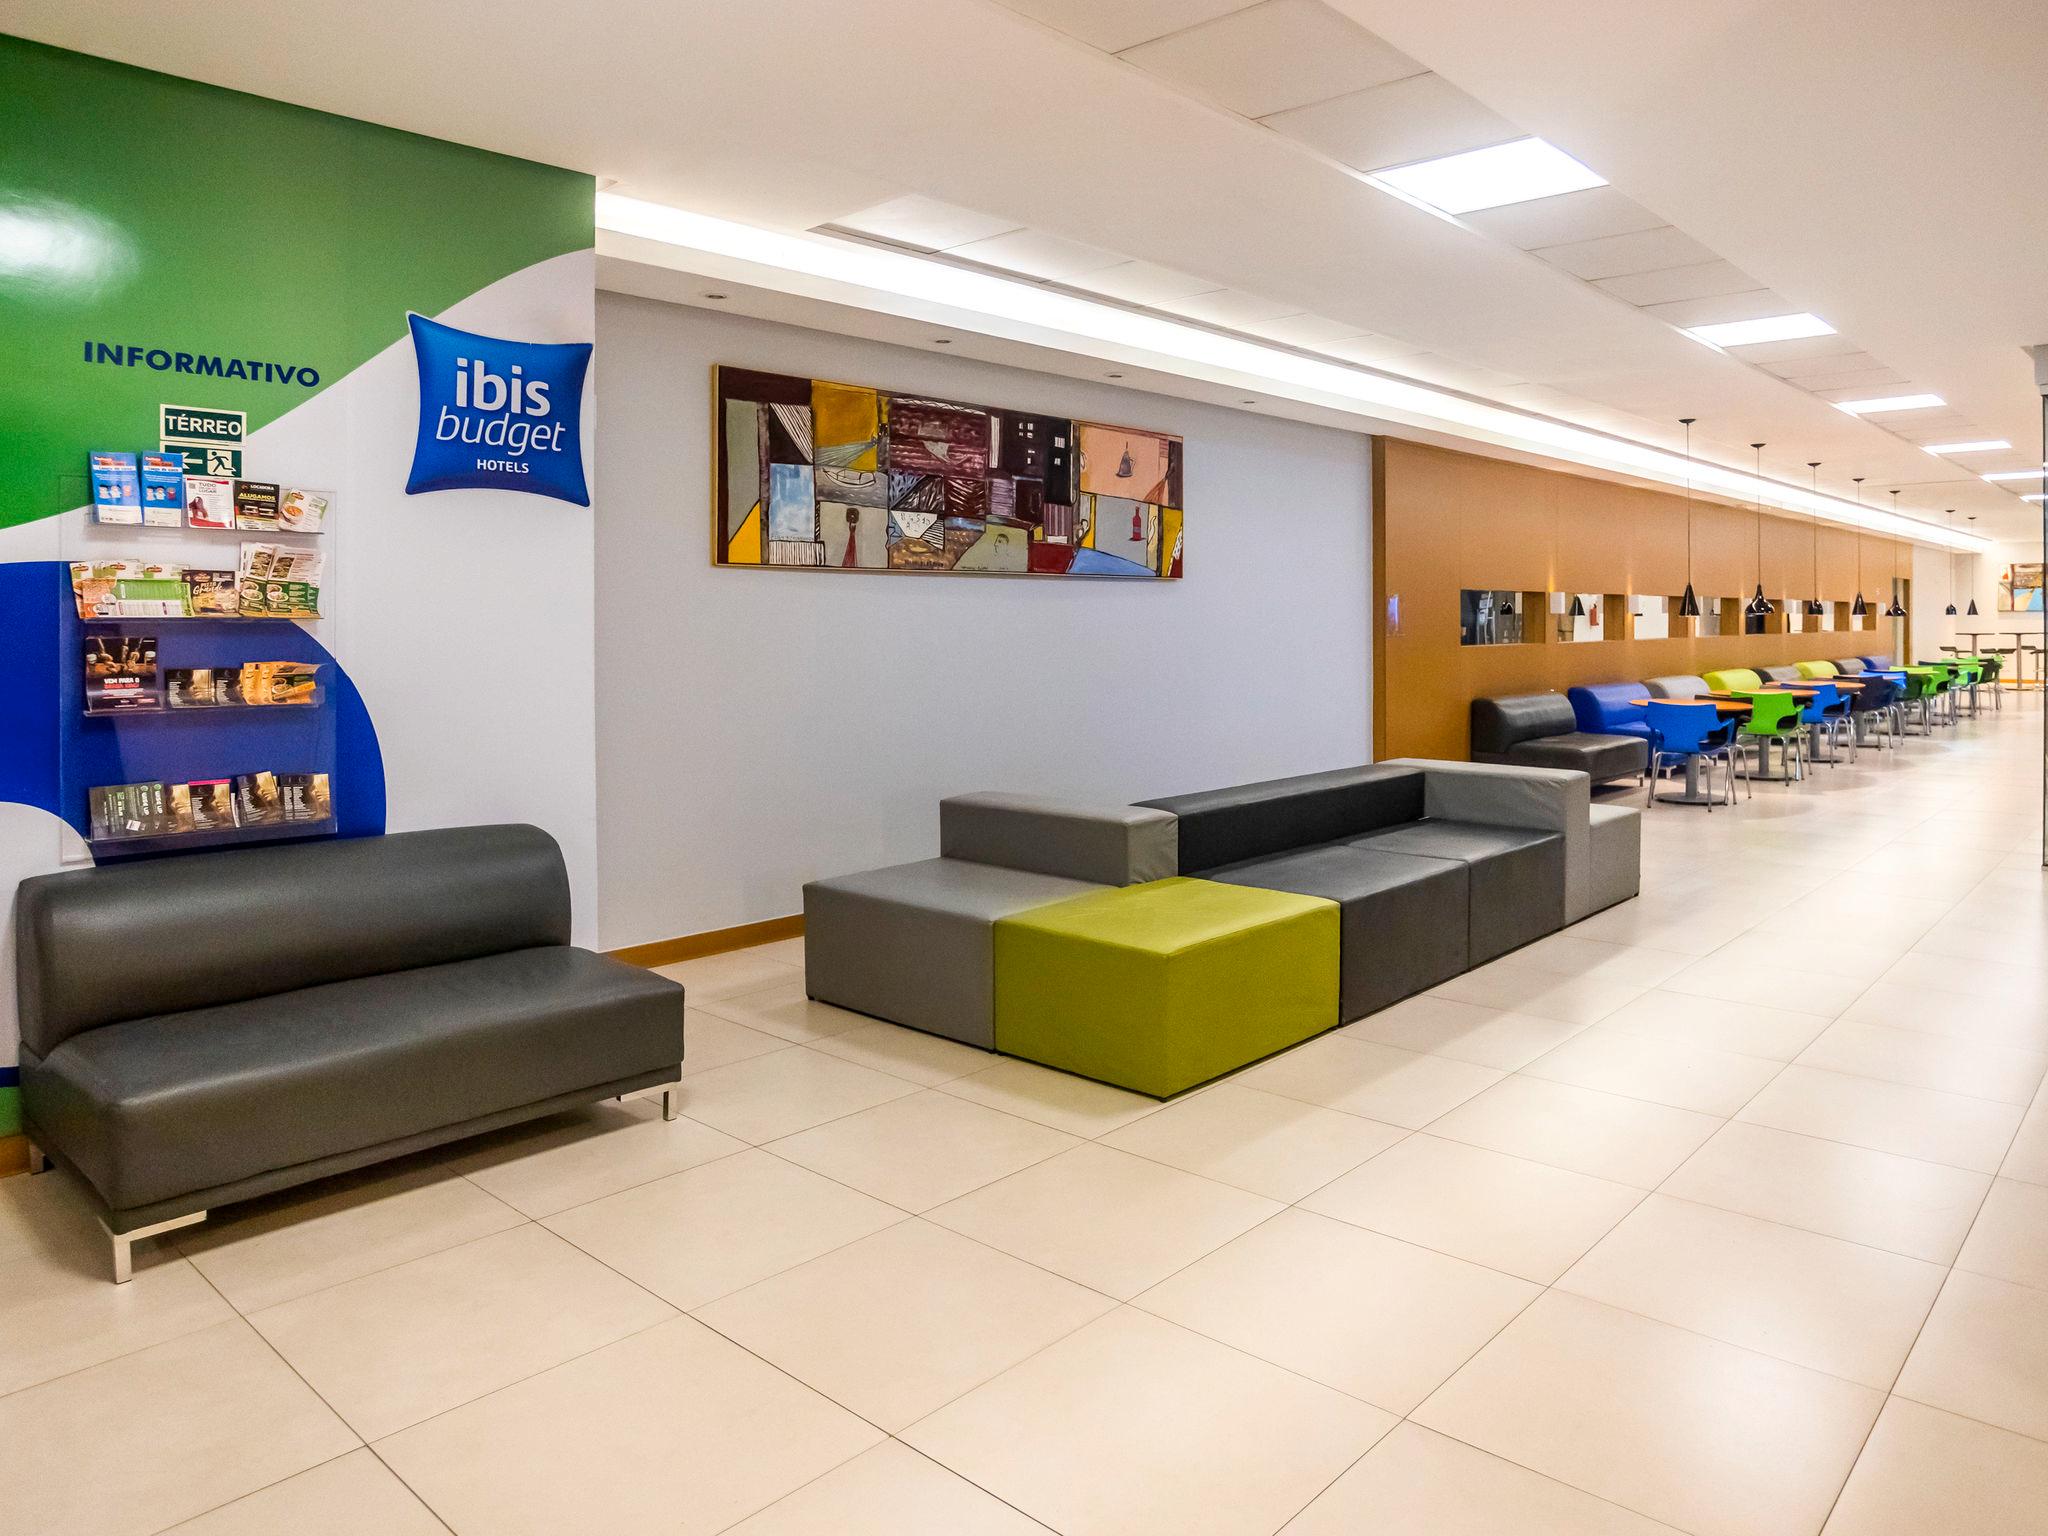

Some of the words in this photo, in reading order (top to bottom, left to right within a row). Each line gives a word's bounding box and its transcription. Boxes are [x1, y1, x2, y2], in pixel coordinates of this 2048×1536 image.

[84, 341, 320, 388] INFORMATIVO
[456, 357, 551, 417] ibis
[165, 413, 242, 436] TÉRREO
[435, 405, 566, 457] budget
[476, 458, 530, 474] HOTELS
[239, 492, 276, 500] ALUGAMOS
